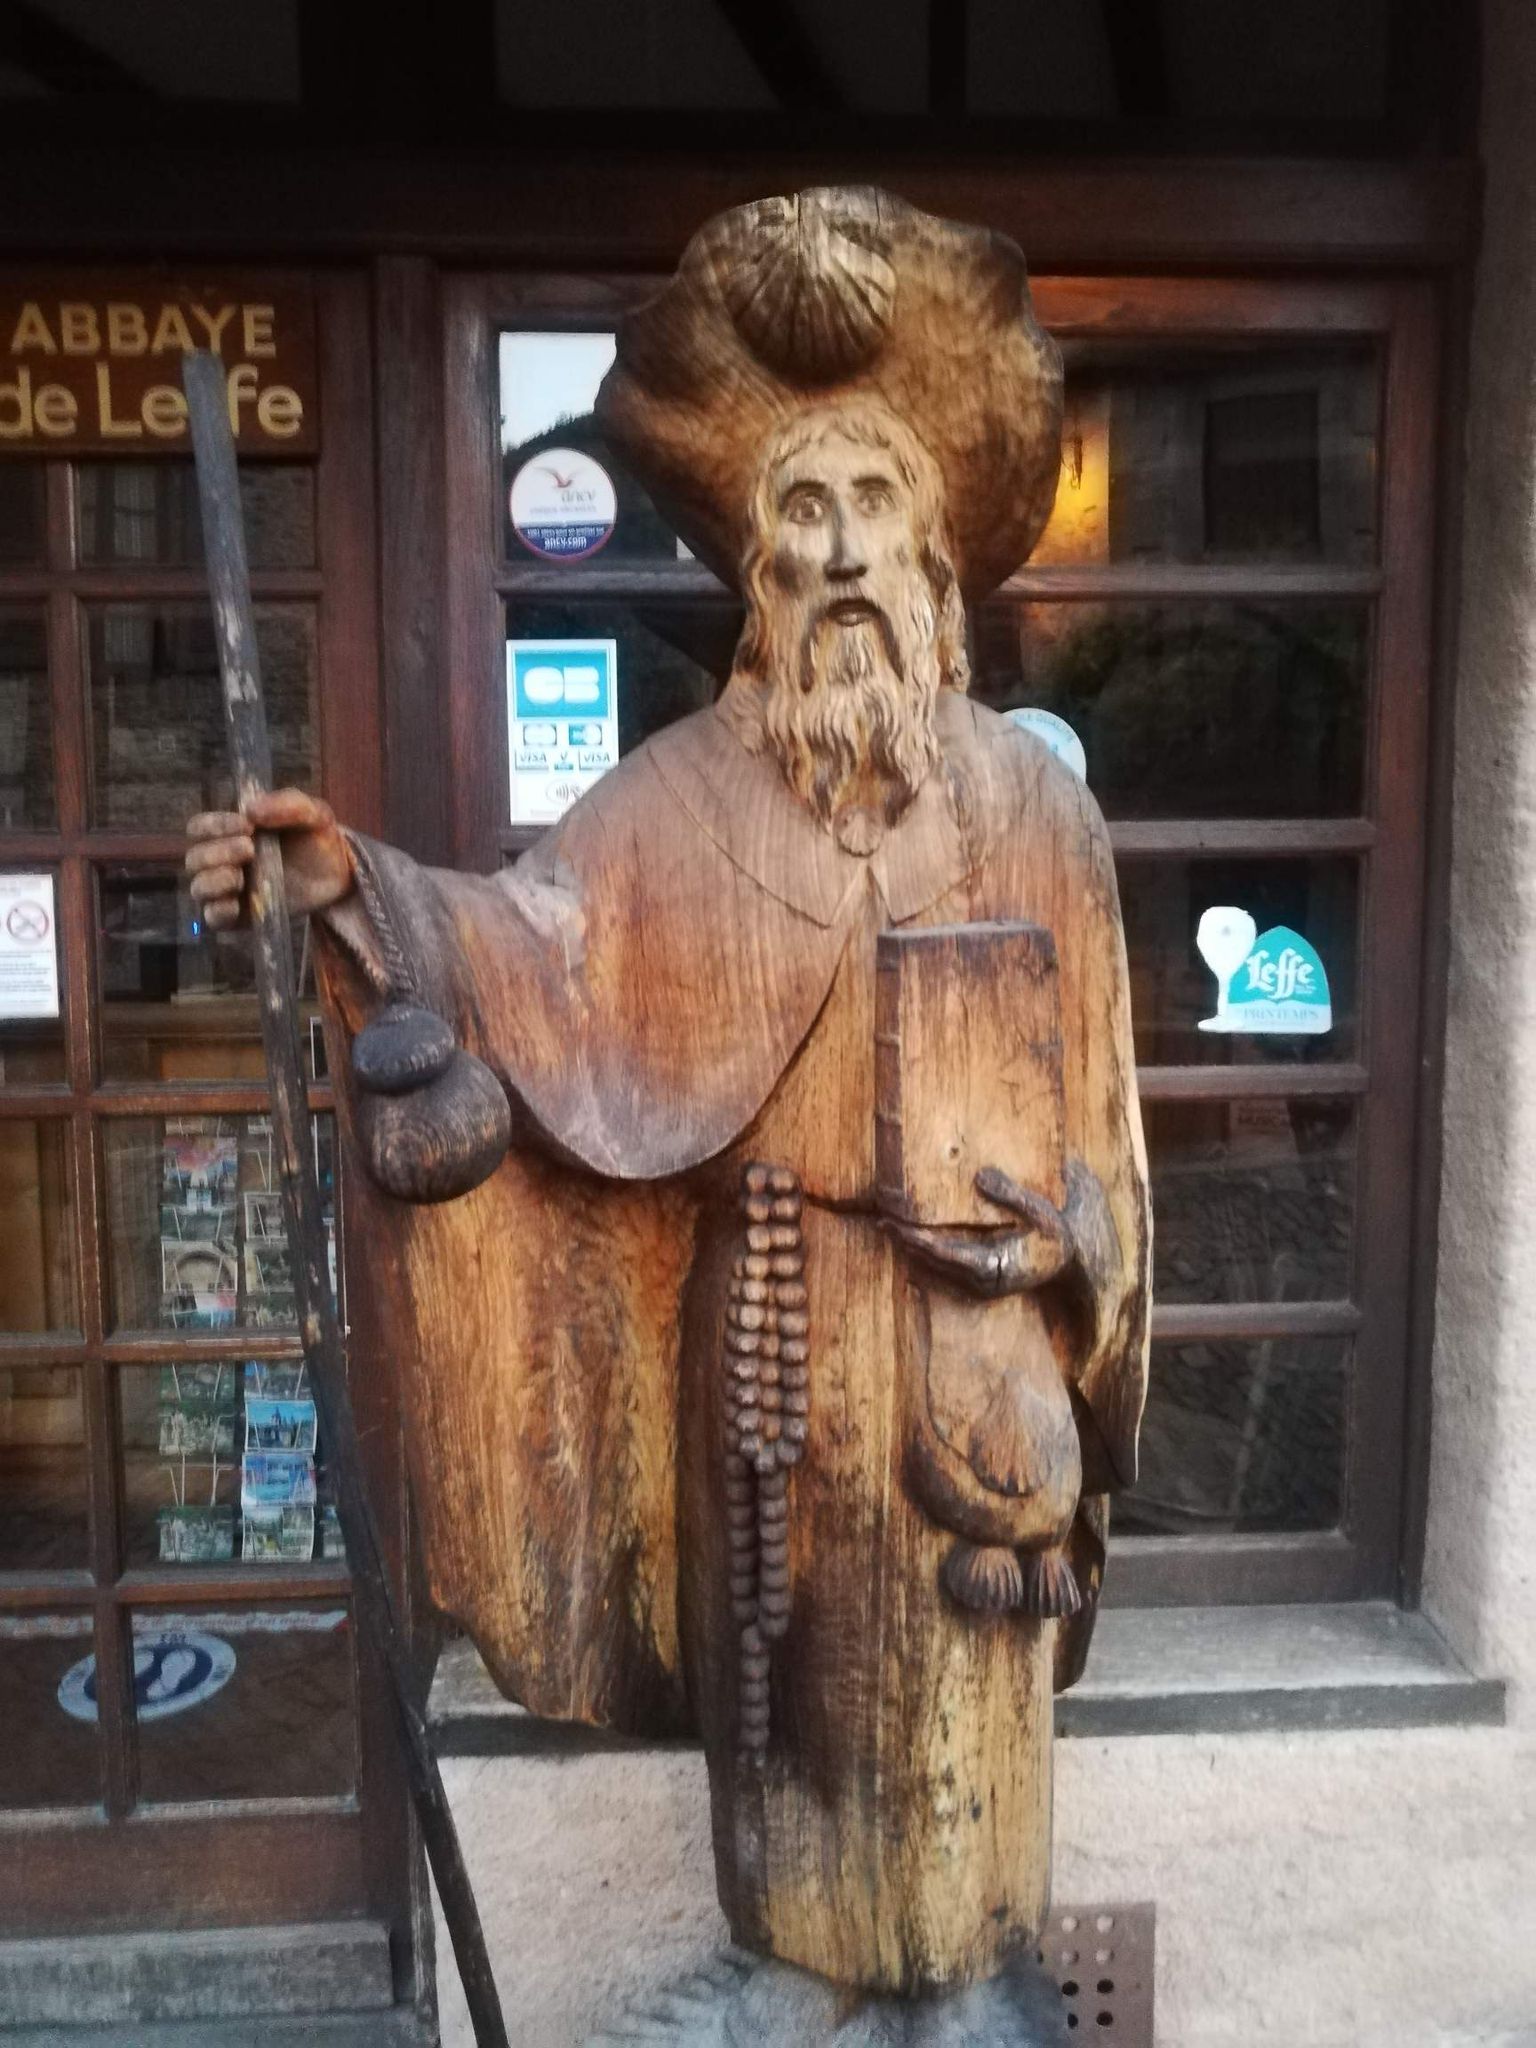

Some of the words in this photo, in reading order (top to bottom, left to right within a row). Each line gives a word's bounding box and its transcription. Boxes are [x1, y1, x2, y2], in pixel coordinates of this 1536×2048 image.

[10, 301, 277, 358] ABBAYE
[0, 362, 78, 438] de
[96, 361, 303, 439] Lefe
[520, 752, 547, 762] VISA
[583, 752, 611, 762] VISA
[1245, 948, 1315, 999] Leffe
